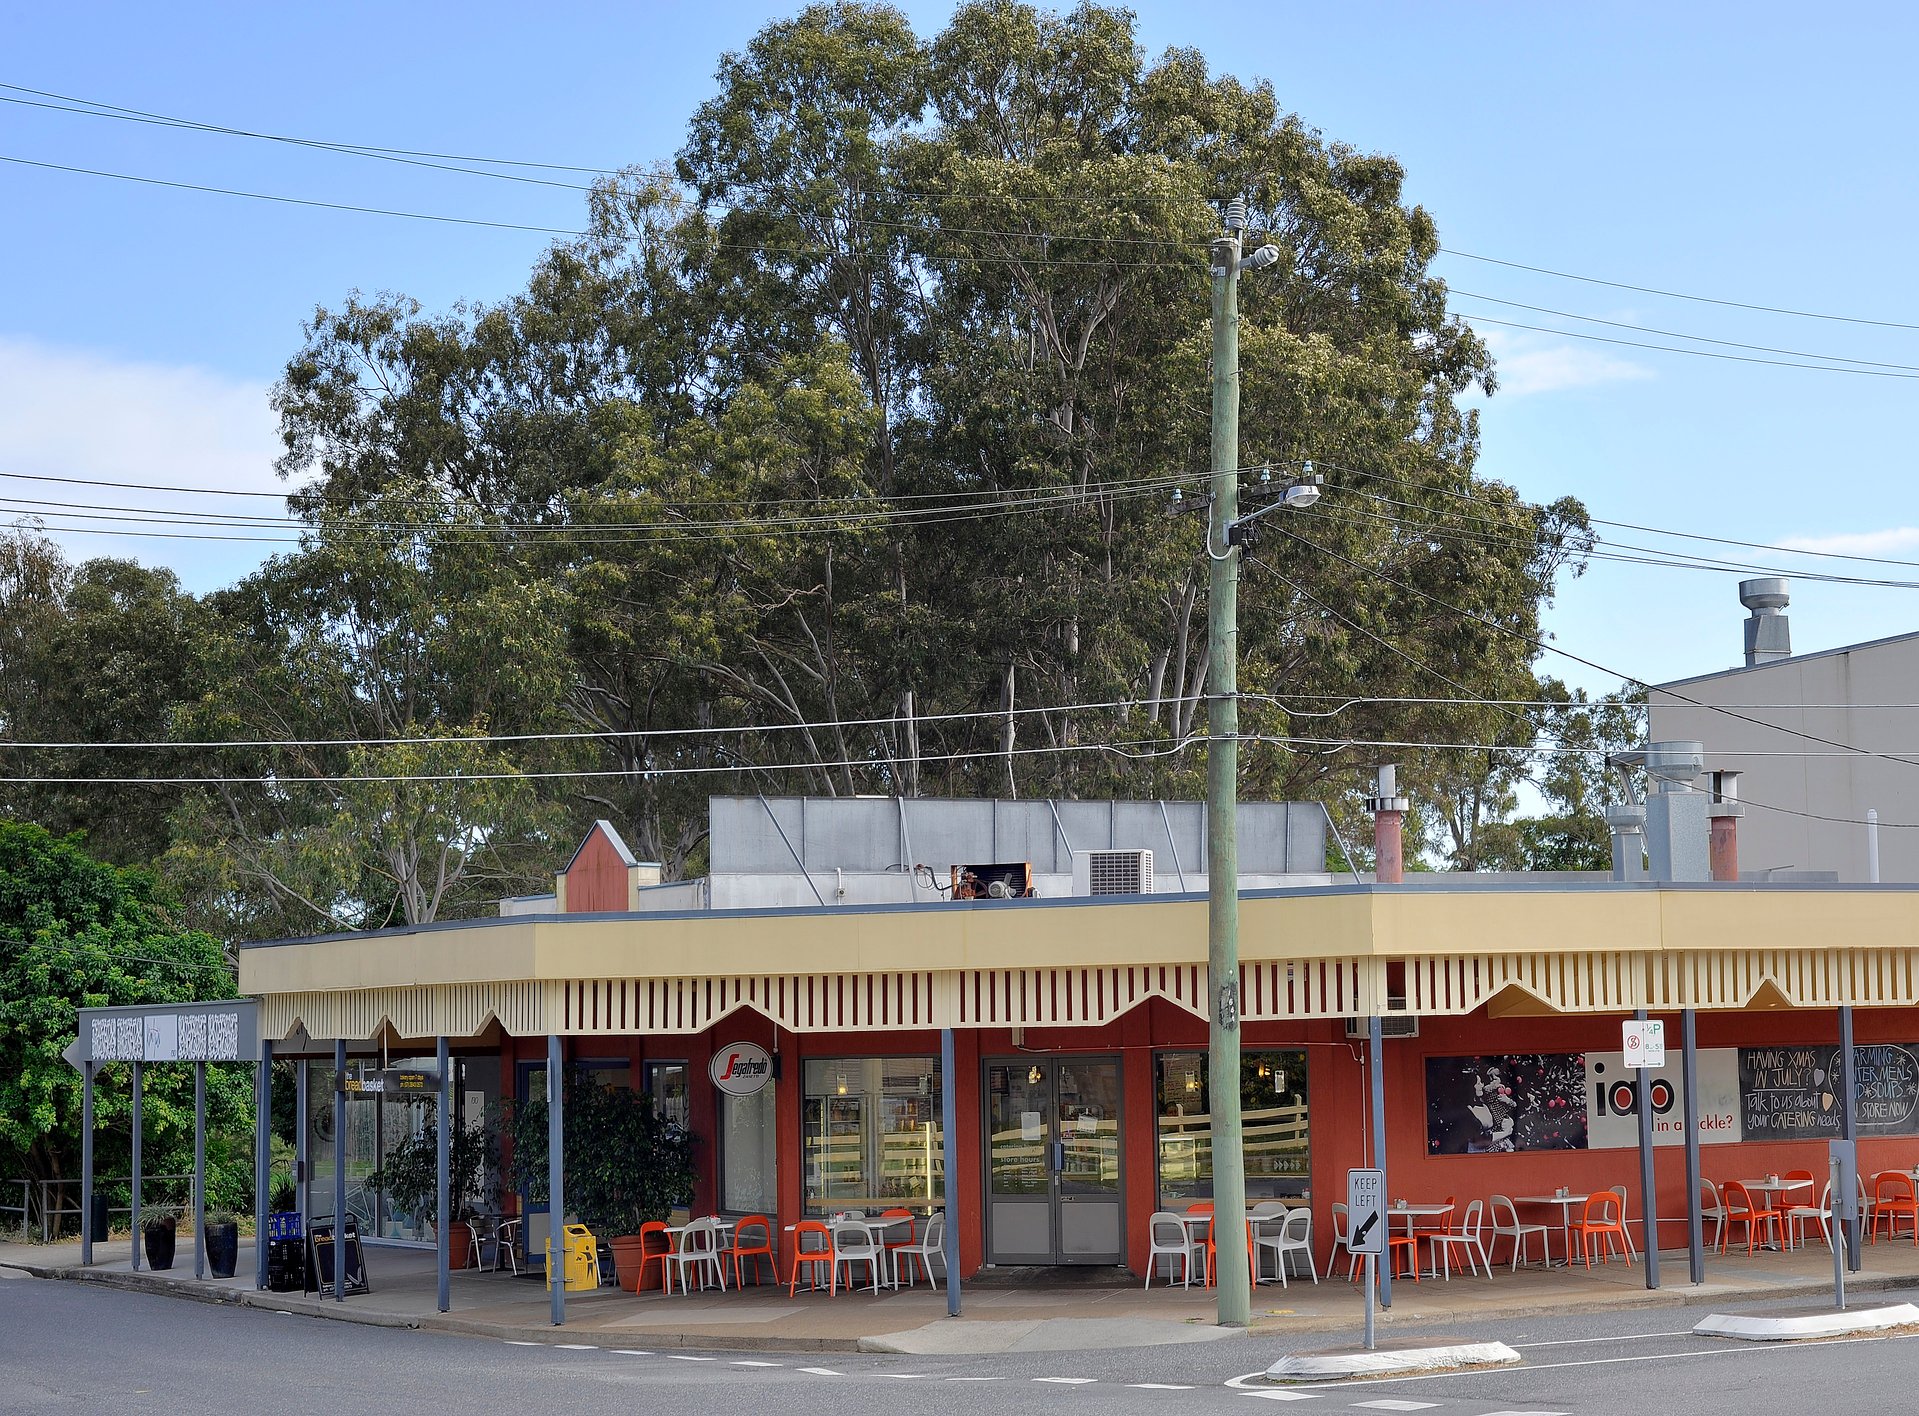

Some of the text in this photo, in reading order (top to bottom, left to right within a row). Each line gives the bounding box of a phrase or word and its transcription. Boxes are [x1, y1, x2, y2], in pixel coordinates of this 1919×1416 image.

[720, 1053, 768, 1080] Segafredo
[1747, 1049, 1816, 1070] HAVING XMAS
[1853, 1047, 1893, 1067] ARMING
[1754, 1067, 1812, 1088] IN JULY?
[1878, 1063, 1913, 1083] MEALS
[1745, 1091, 1821, 1112] Talk to us about
[1862, 1102, 1888, 1119] STORE
[1888, 1101, 1909, 1118] NOW
[1657, 1114, 1733, 1132] in a ickle?
[1747, 1113, 1770, 1130] your
[1771, 1110, 1816, 1129] CATERING
[1354, 1177, 1377, 1190] KEEP
[1355, 1194, 1376, 1207] LEFT
